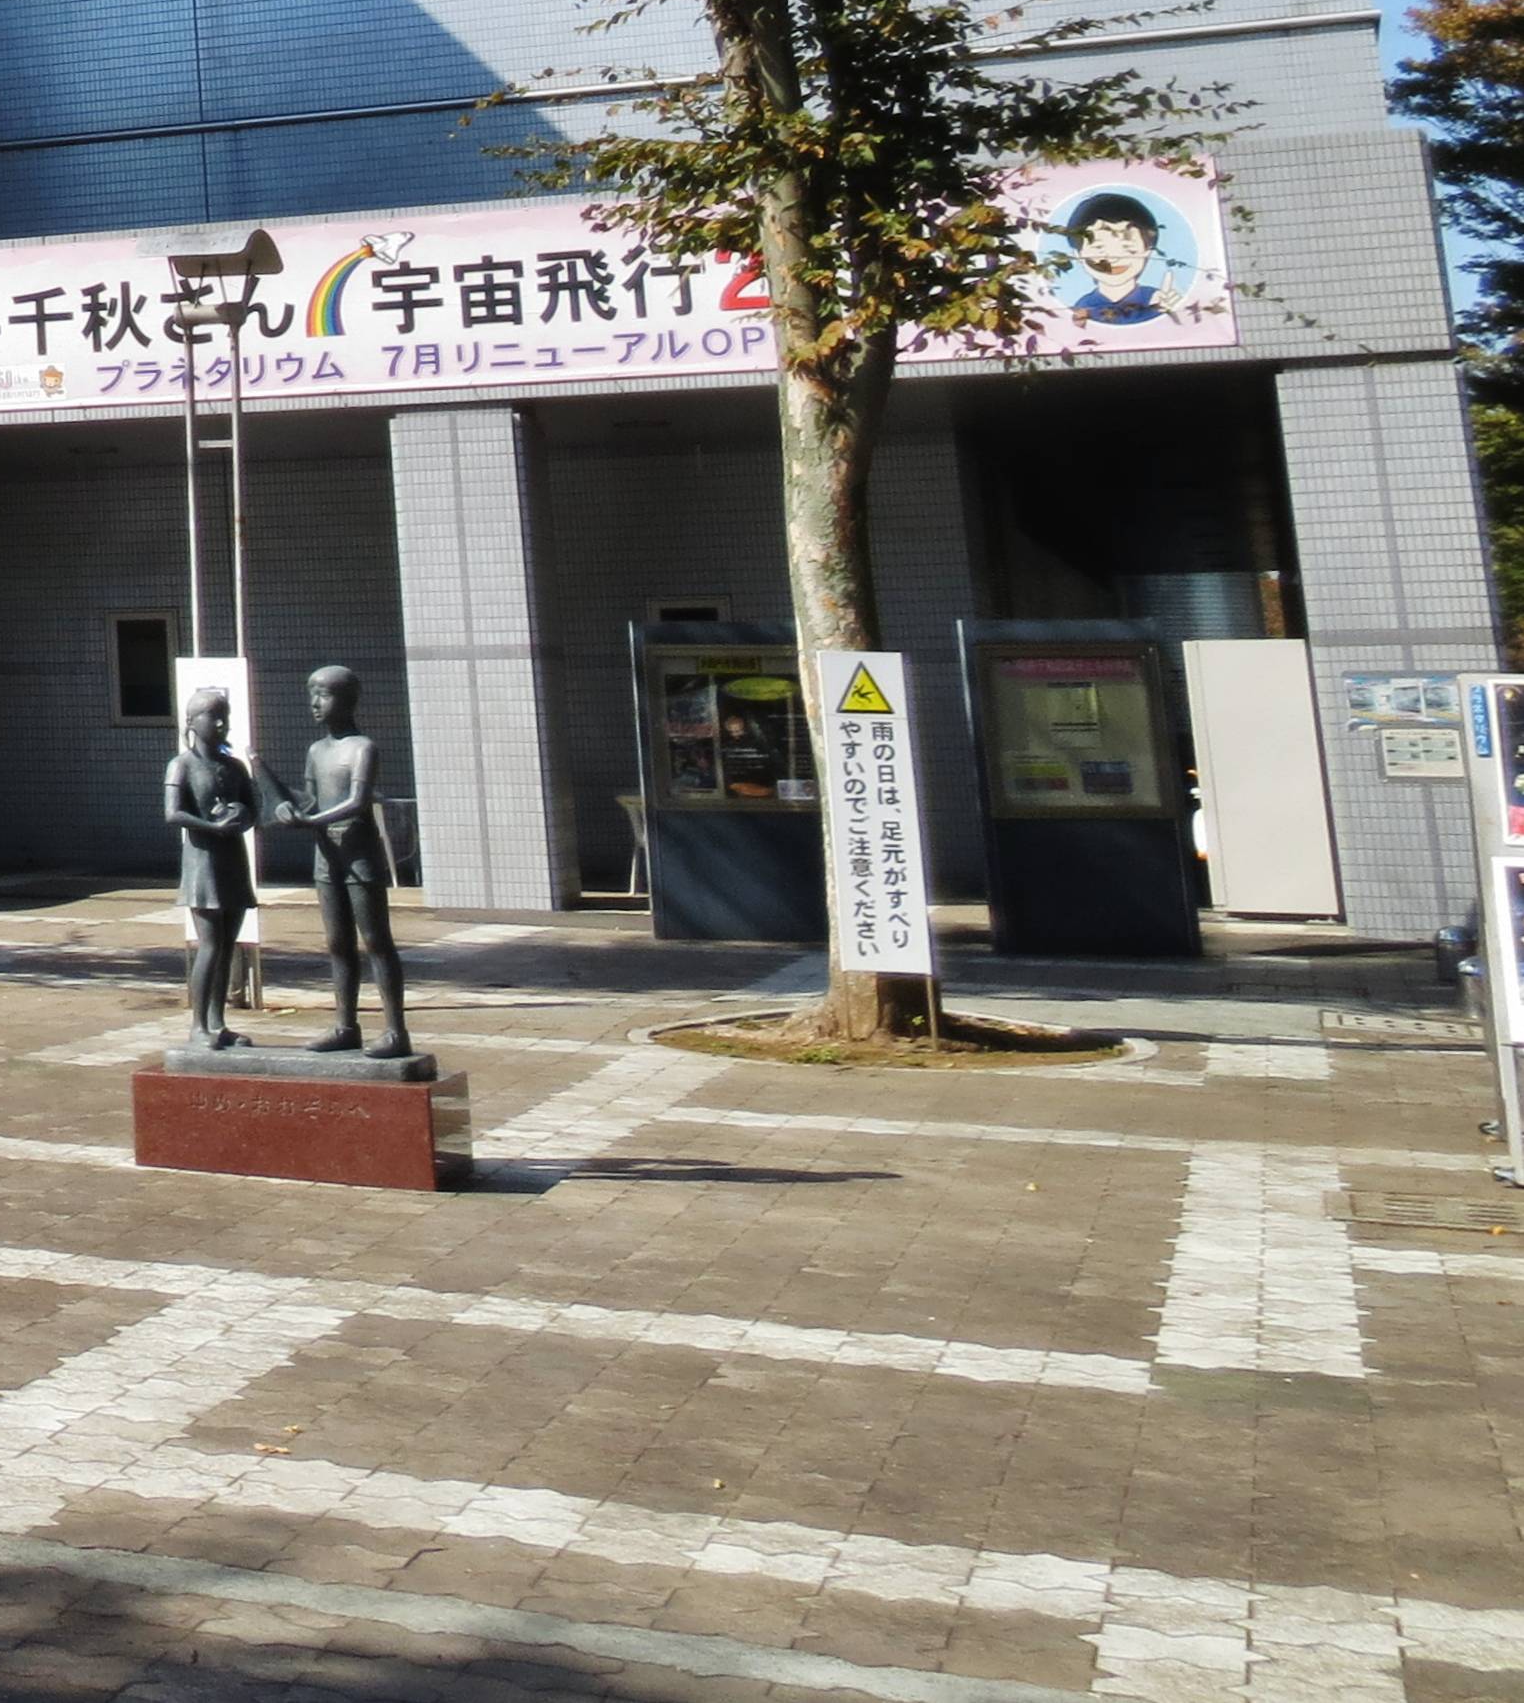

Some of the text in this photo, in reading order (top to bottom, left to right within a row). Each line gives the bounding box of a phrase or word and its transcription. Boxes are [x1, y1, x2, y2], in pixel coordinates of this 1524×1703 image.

[370, 245, 770, 335] 宇宙飛行2
[96, 350, 345, 394] プラネタリウム
[839, 720, 880, 957] やすいのでご注意ください
[870, 720, 911, 949] 雨の日は、足元がすべり
